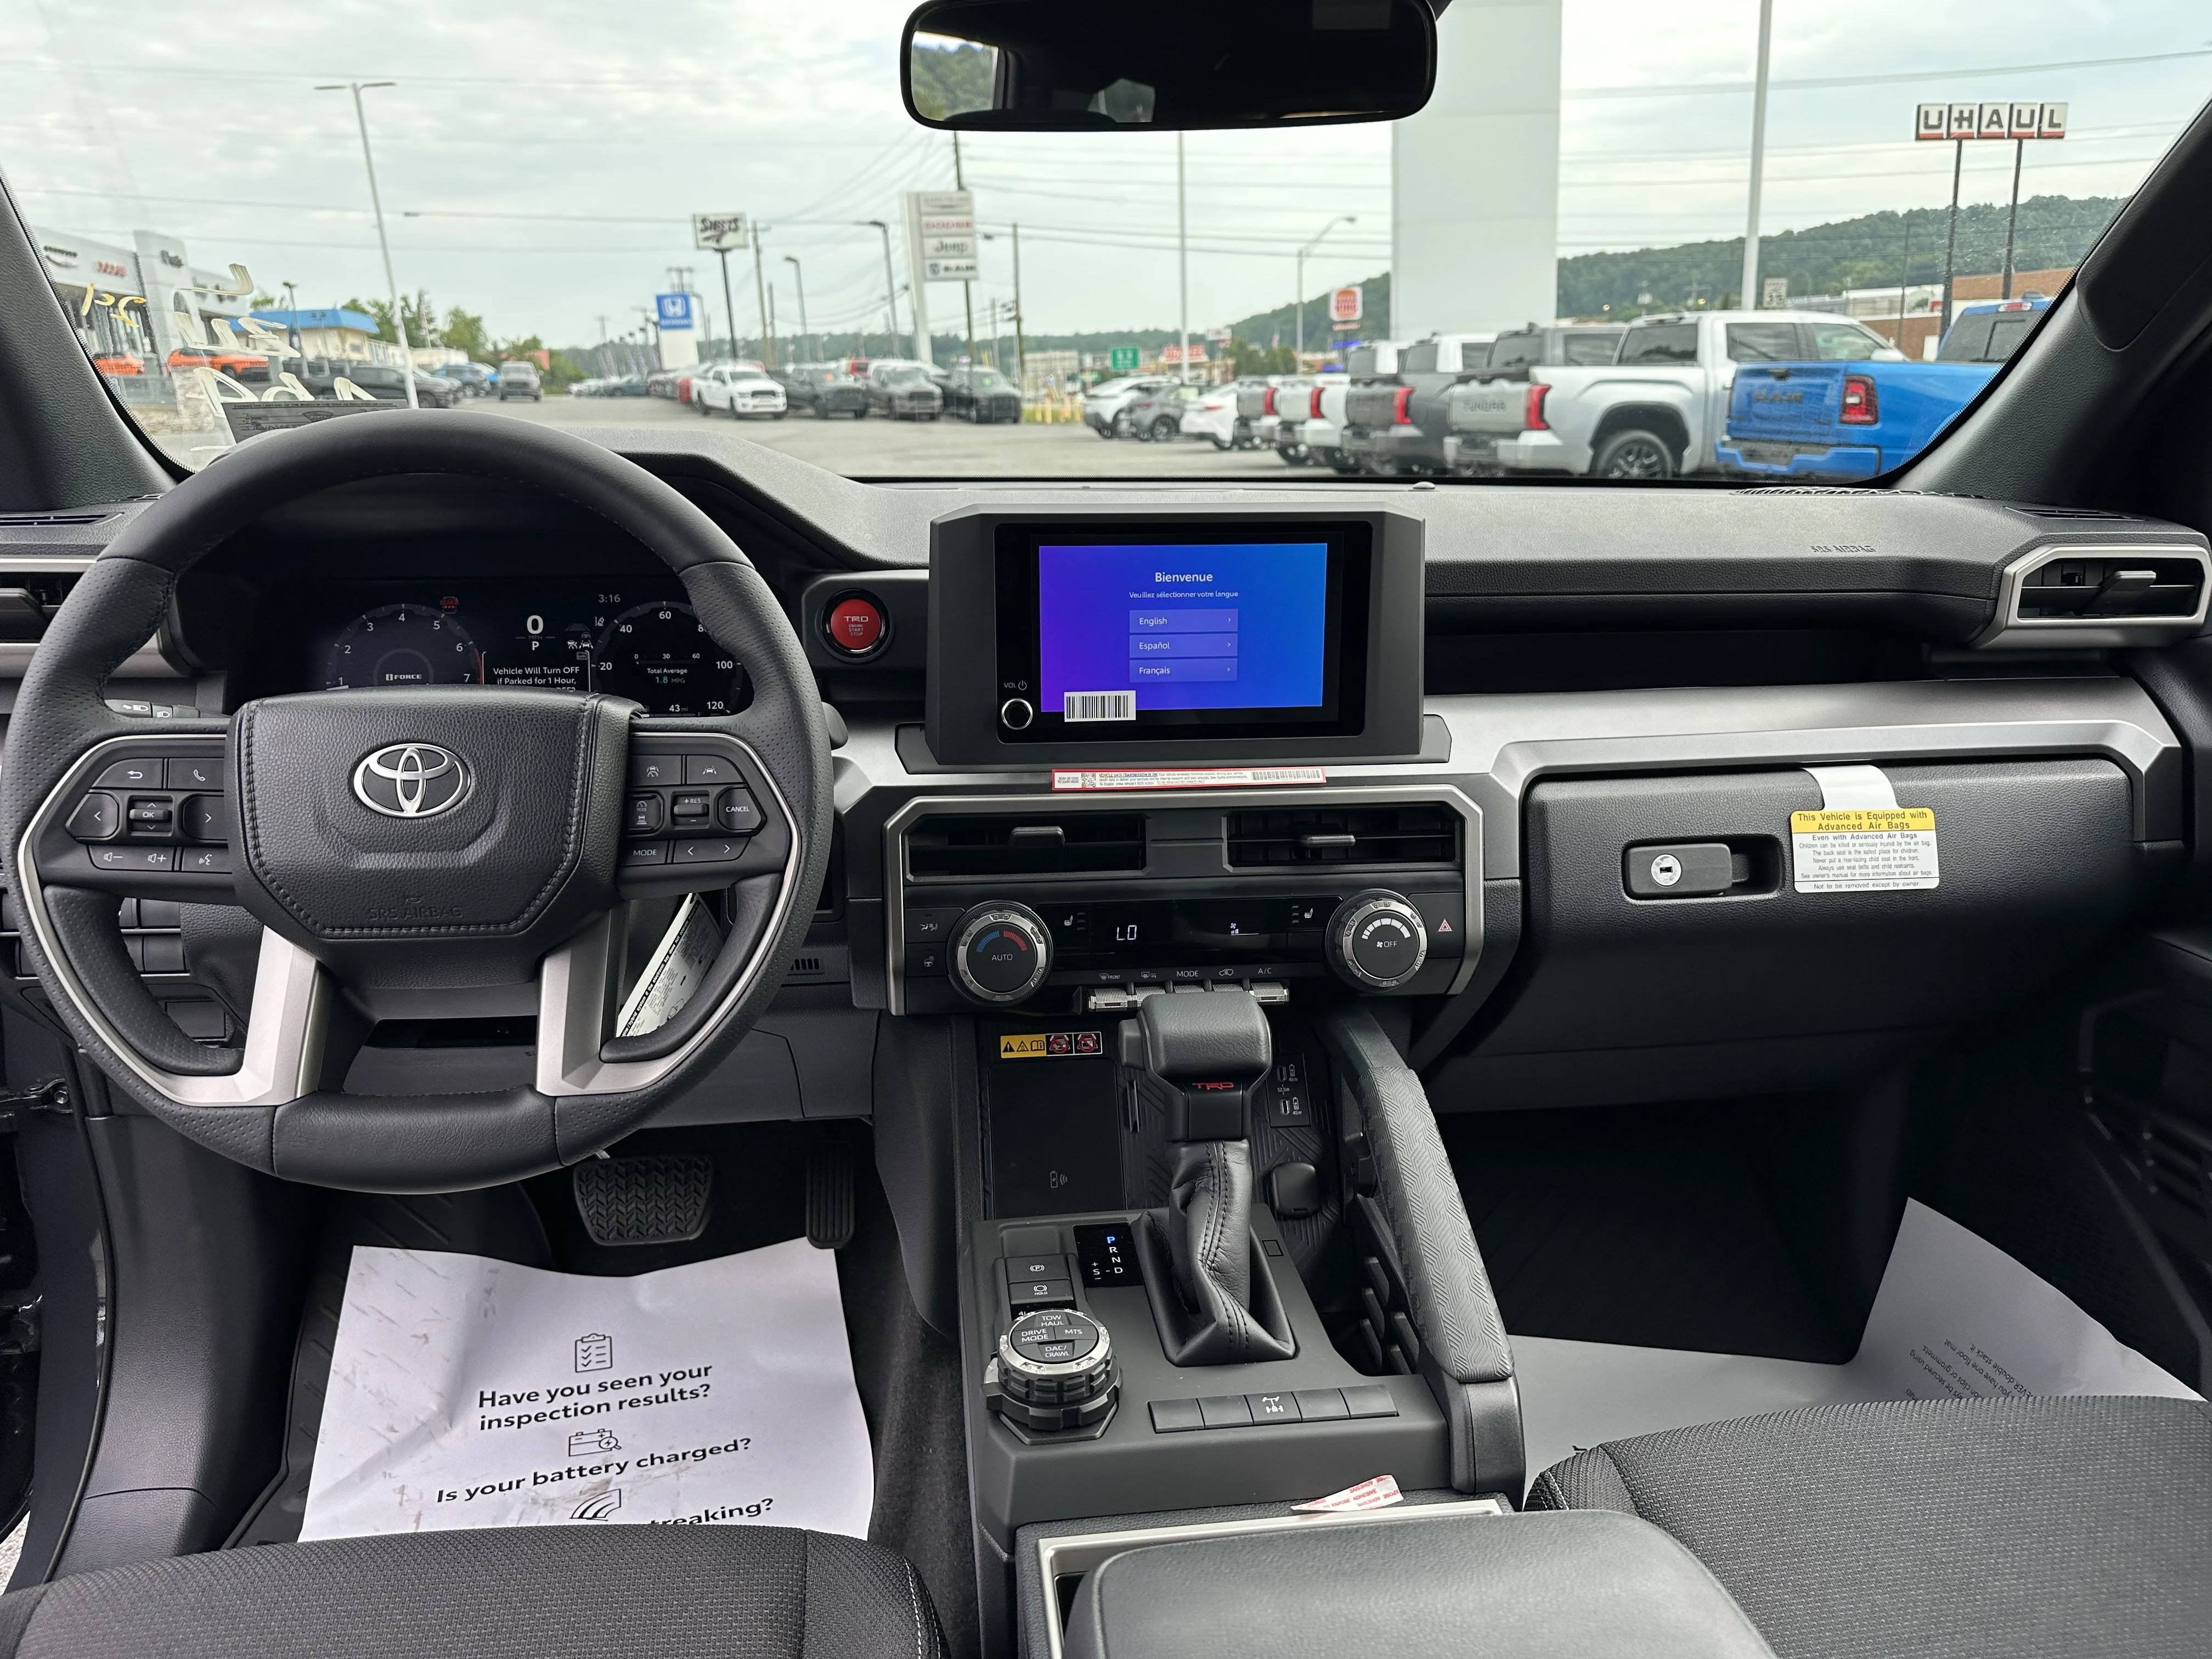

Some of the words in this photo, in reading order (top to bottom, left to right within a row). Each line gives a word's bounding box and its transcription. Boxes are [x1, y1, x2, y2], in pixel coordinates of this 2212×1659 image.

[1155, 572, 1213, 582] Bienvenue
[599, 594, 620, 603] 3:16
[1215, 590, 1238, 599] langue
[399, 613, 405, 622] 4
[659, 611, 672, 619] 60
[367, 623, 374, 631] 3
[433, 621, 440, 629] 5
[527, 615, 543, 634] 0
[1139, 617, 1167, 627] English
[620, 624, 632, 633] 40
[345, 646, 351, 654] 2
[456, 643, 463, 652] 6
[532, 641, 539, 650] P
[1139, 642, 1170, 651] Español
[600, 662, 612, 670] 20
[716, 661, 733, 669] 100
[1138, 666, 1171, 677] Français
[464, 674, 470, 682] 7
[707, 701, 724, 710] 120
[1867, 811, 1905, 821] Equipped
[1818, 822, 1862, 831] Advanced
[404, 907, 462, 919] AIRBAG
[1116, 924, 1137, 940] LO
[1022, 1329, 1047, 1337] DRIVE
[1022, 1334, 1049, 1342] MODE
[1944, 1338, 1957, 1351] mat
[1910, 1349, 1924, 1365] using
[1922, 1345, 1952, 1372] grommets.
[1957, 1352, 1972, 1365] floor
[1976, 1348, 1993, 1364] stack
[1972, 1363, 1984, 1374] one
[1993, 1363, 2014, 1384] double
[1923, 1364, 1945, 1385] secured
[1950, 1370, 1957, 1379] or
[478, 1390, 540, 1408] Have
[546, 1384, 591, 1403] you
[598, 1374, 653, 1392] seen
[658, 1365, 713, 1387] your
[1957, 1377, 1971, 1390] clips
[1983, 1374, 1999, 1389] have
[1945, 1383, 1953, 1393] be
[1999, 1386, 2012, 1397] you
[2013, 1381, 2033, 1398] EVER
[479, 1400, 611, 1431] inspection
[618, 1383, 711, 1410] results?
[437, 1489, 457, 1503] Is
[464, 1477, 526, 1502] your
[533, 1459, 629, 1486] battery
[636, 1437, 752, 1468] charged?
[1353, 1488, 1377, 1500] ADHESIVE
